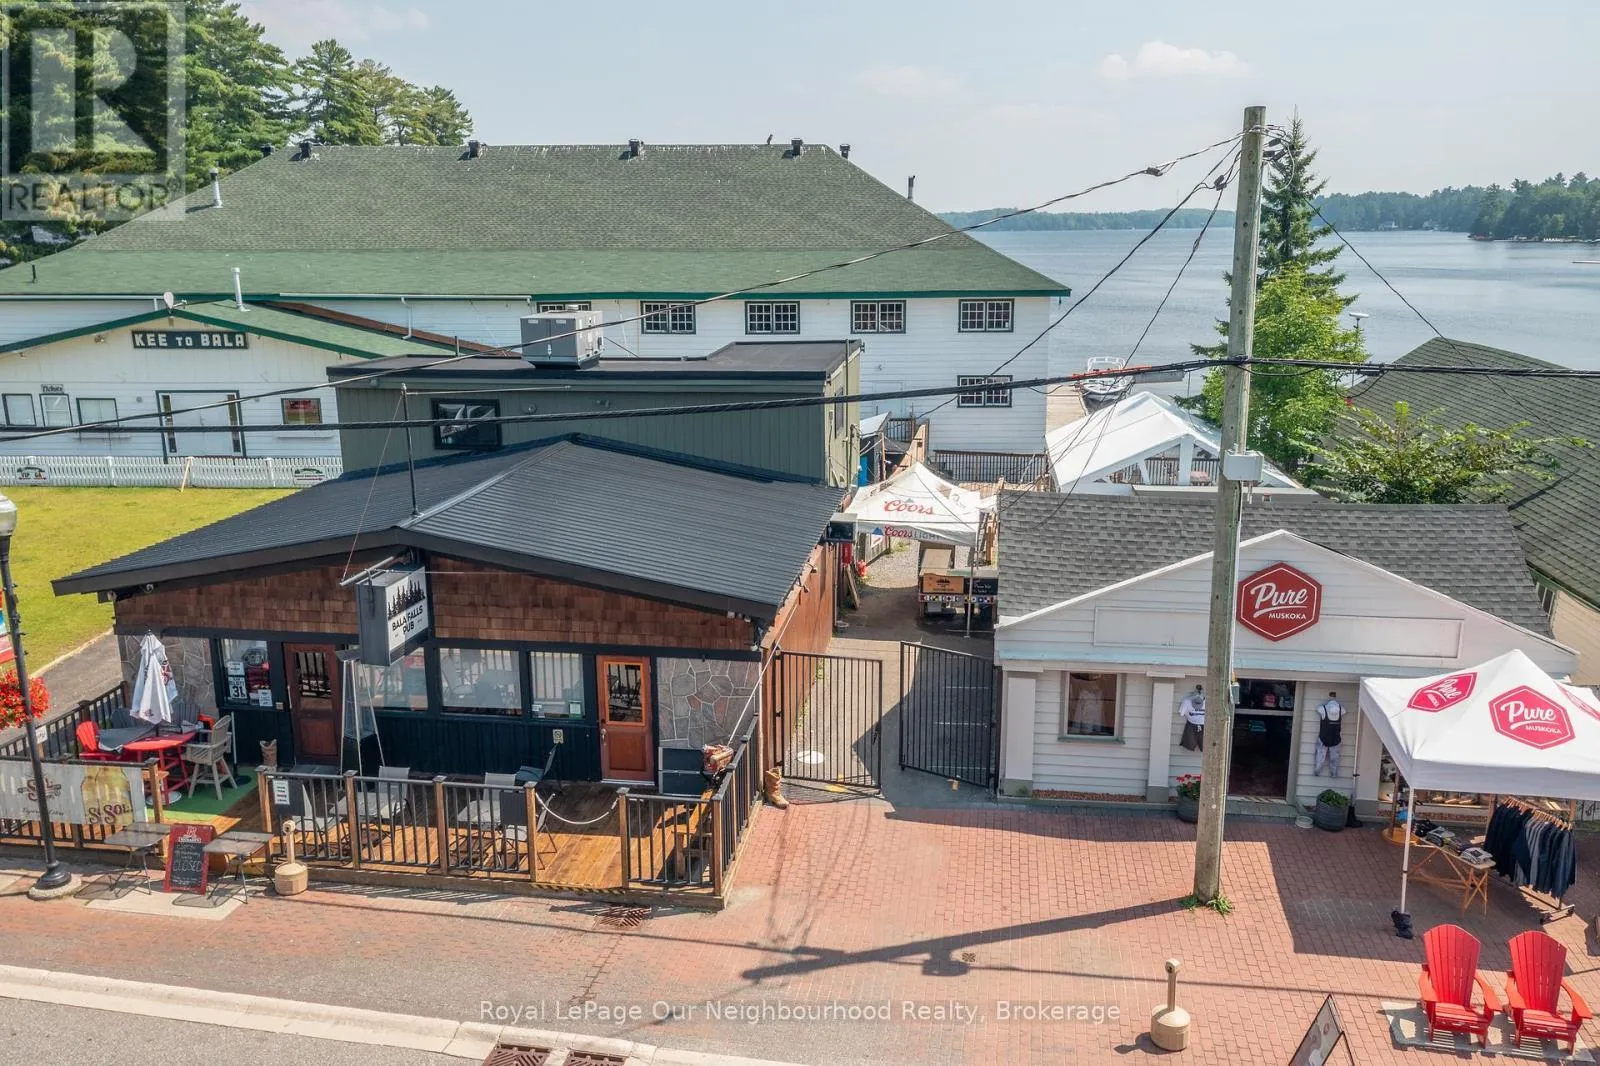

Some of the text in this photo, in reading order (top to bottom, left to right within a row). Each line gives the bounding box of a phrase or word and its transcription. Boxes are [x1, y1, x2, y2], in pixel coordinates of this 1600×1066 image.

[134, 333, 245, 347] KEE TO BALA
[884, 499, 934, 515] Coors
[884, 525, 913, 538] Coors
[1250, 582, 1308, 610] Pure
[392, 605, 423, 631] BALA FALLS
[403, 621, 414, 634] PUB
[1500, 700, 1556, 723] Pure
